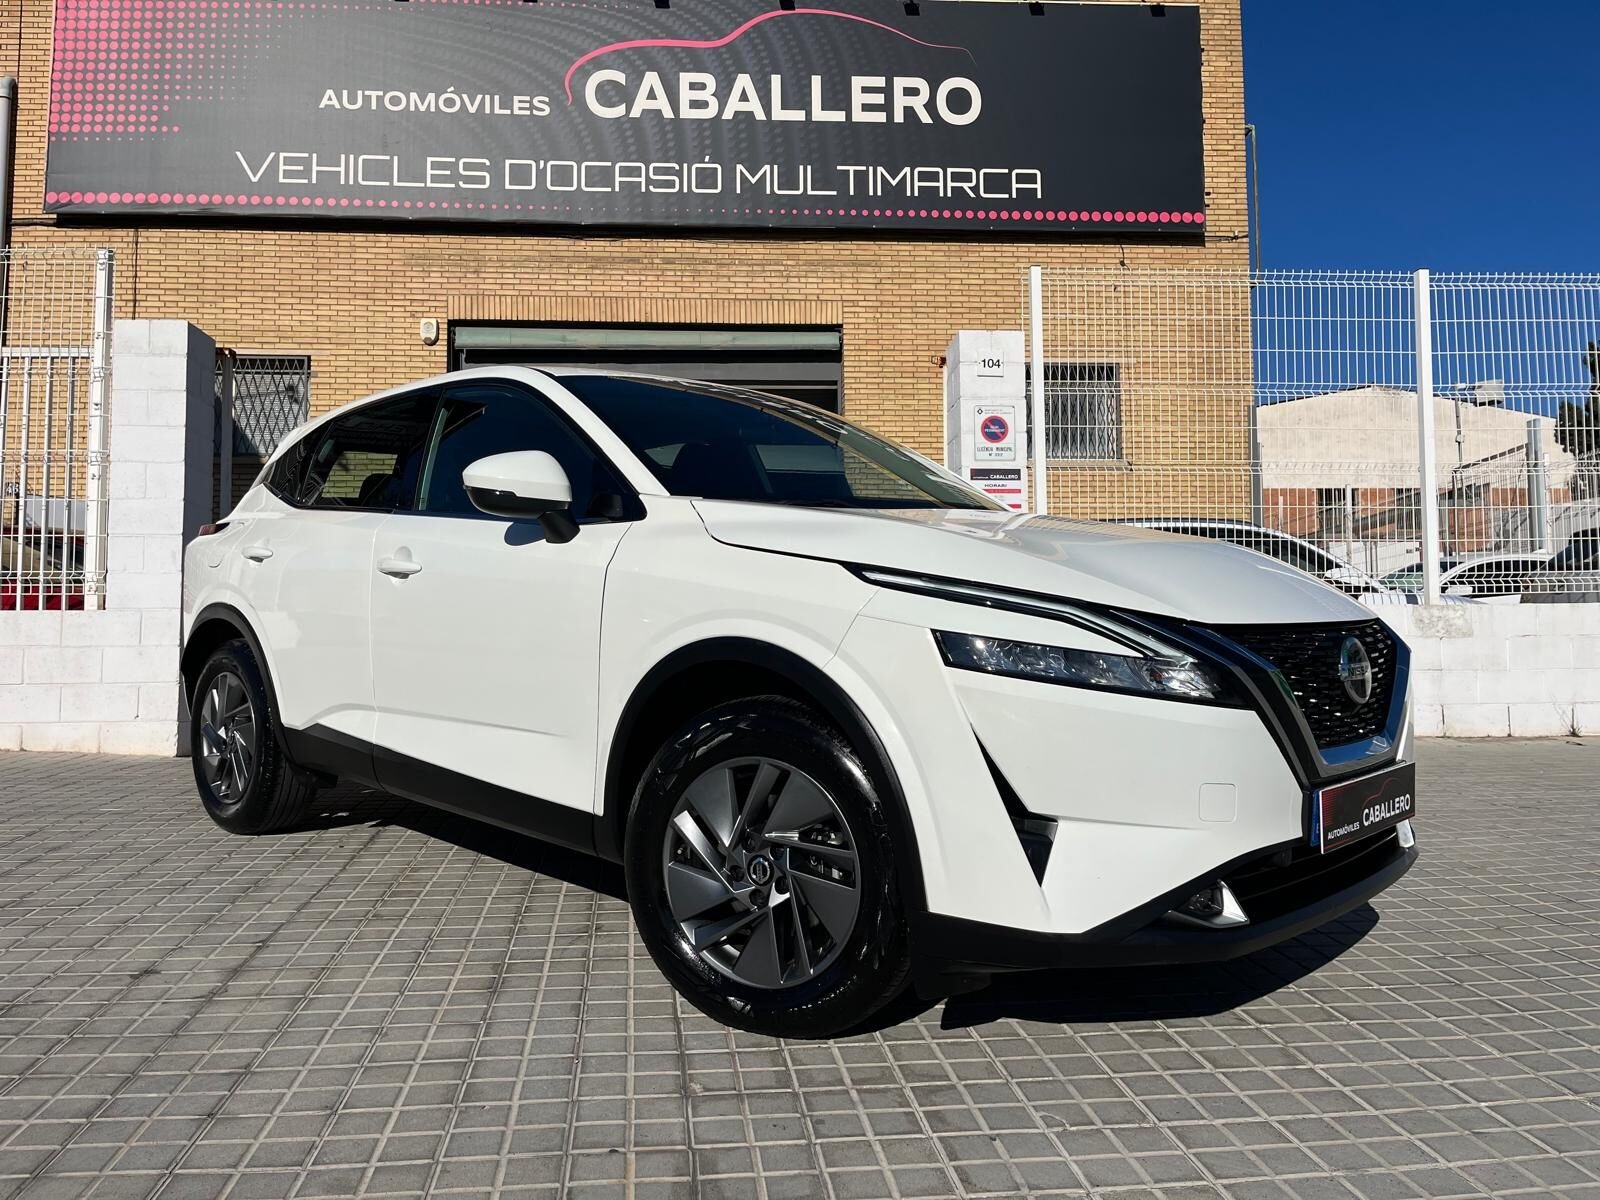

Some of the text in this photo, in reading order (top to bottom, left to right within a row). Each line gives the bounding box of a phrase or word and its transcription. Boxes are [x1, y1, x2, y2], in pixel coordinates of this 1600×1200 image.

[318, 68, 982, 126] AUTOMÓVILES CABALLERO
[235, 151, 1042, 198] VEHICLES D'OCASIÓ MULTIMARCA
[981, 358, 1001, 369] 104
[1327, 821, 1360, 840] AUTOMÓVILES
[1362, 794, 1411, 826] CABALLERO
